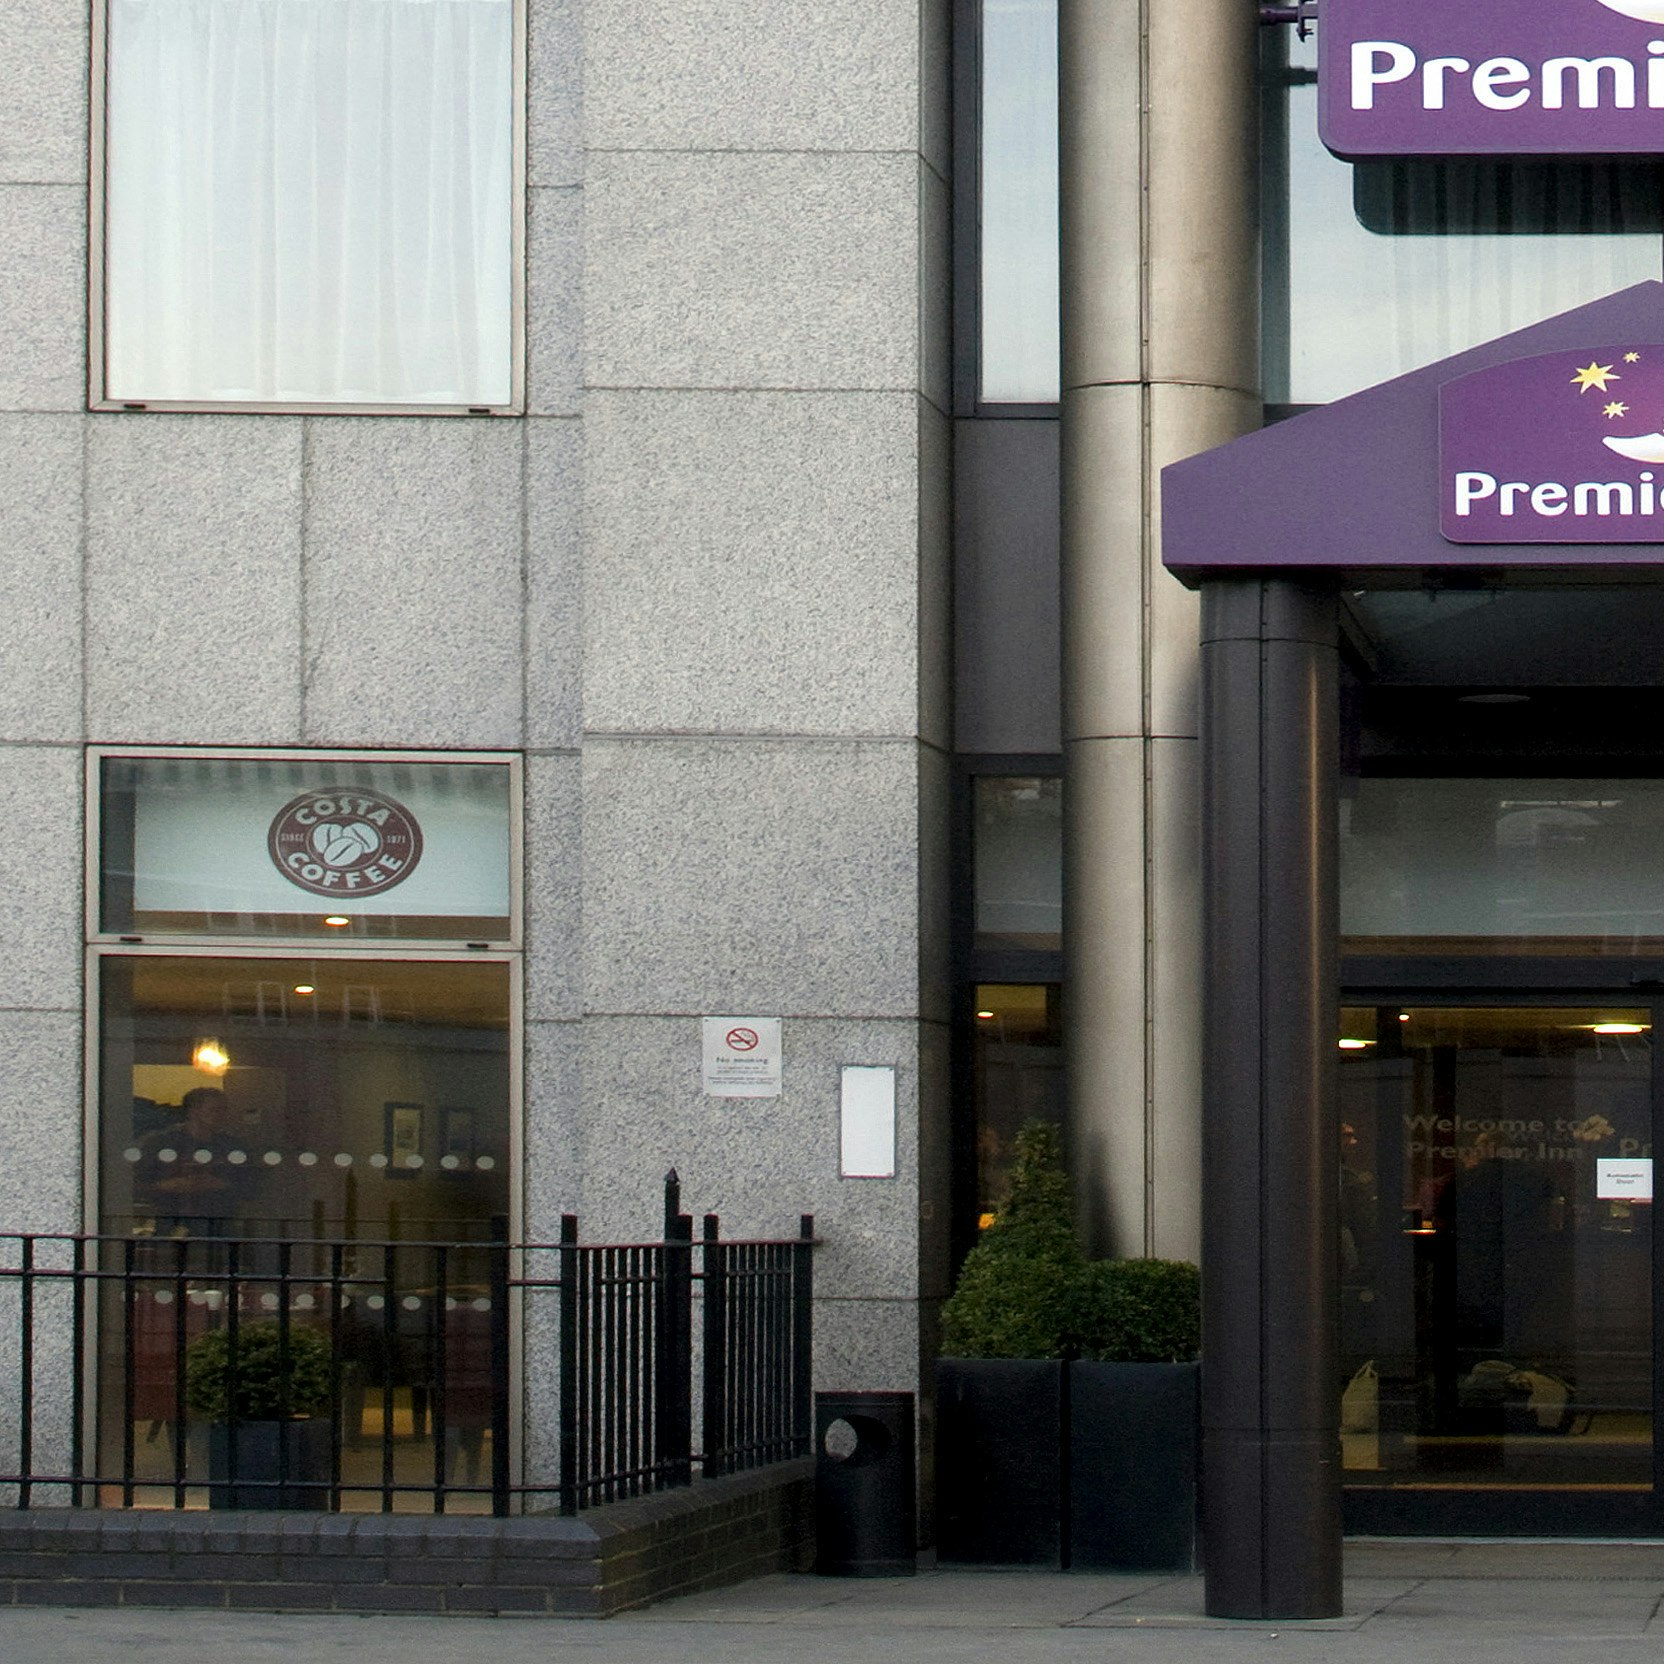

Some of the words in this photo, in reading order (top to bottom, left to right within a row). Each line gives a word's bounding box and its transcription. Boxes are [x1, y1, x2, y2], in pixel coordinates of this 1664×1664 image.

[294, 796, 392, 826] COSTA
[287, 852, 404, 888] COFFEE
[1402, 1114, 1544, 1133] Welcome
[1406, 1141, 1528, 1159] Premier
[1538, 1142, 1583, 1159] Inn
